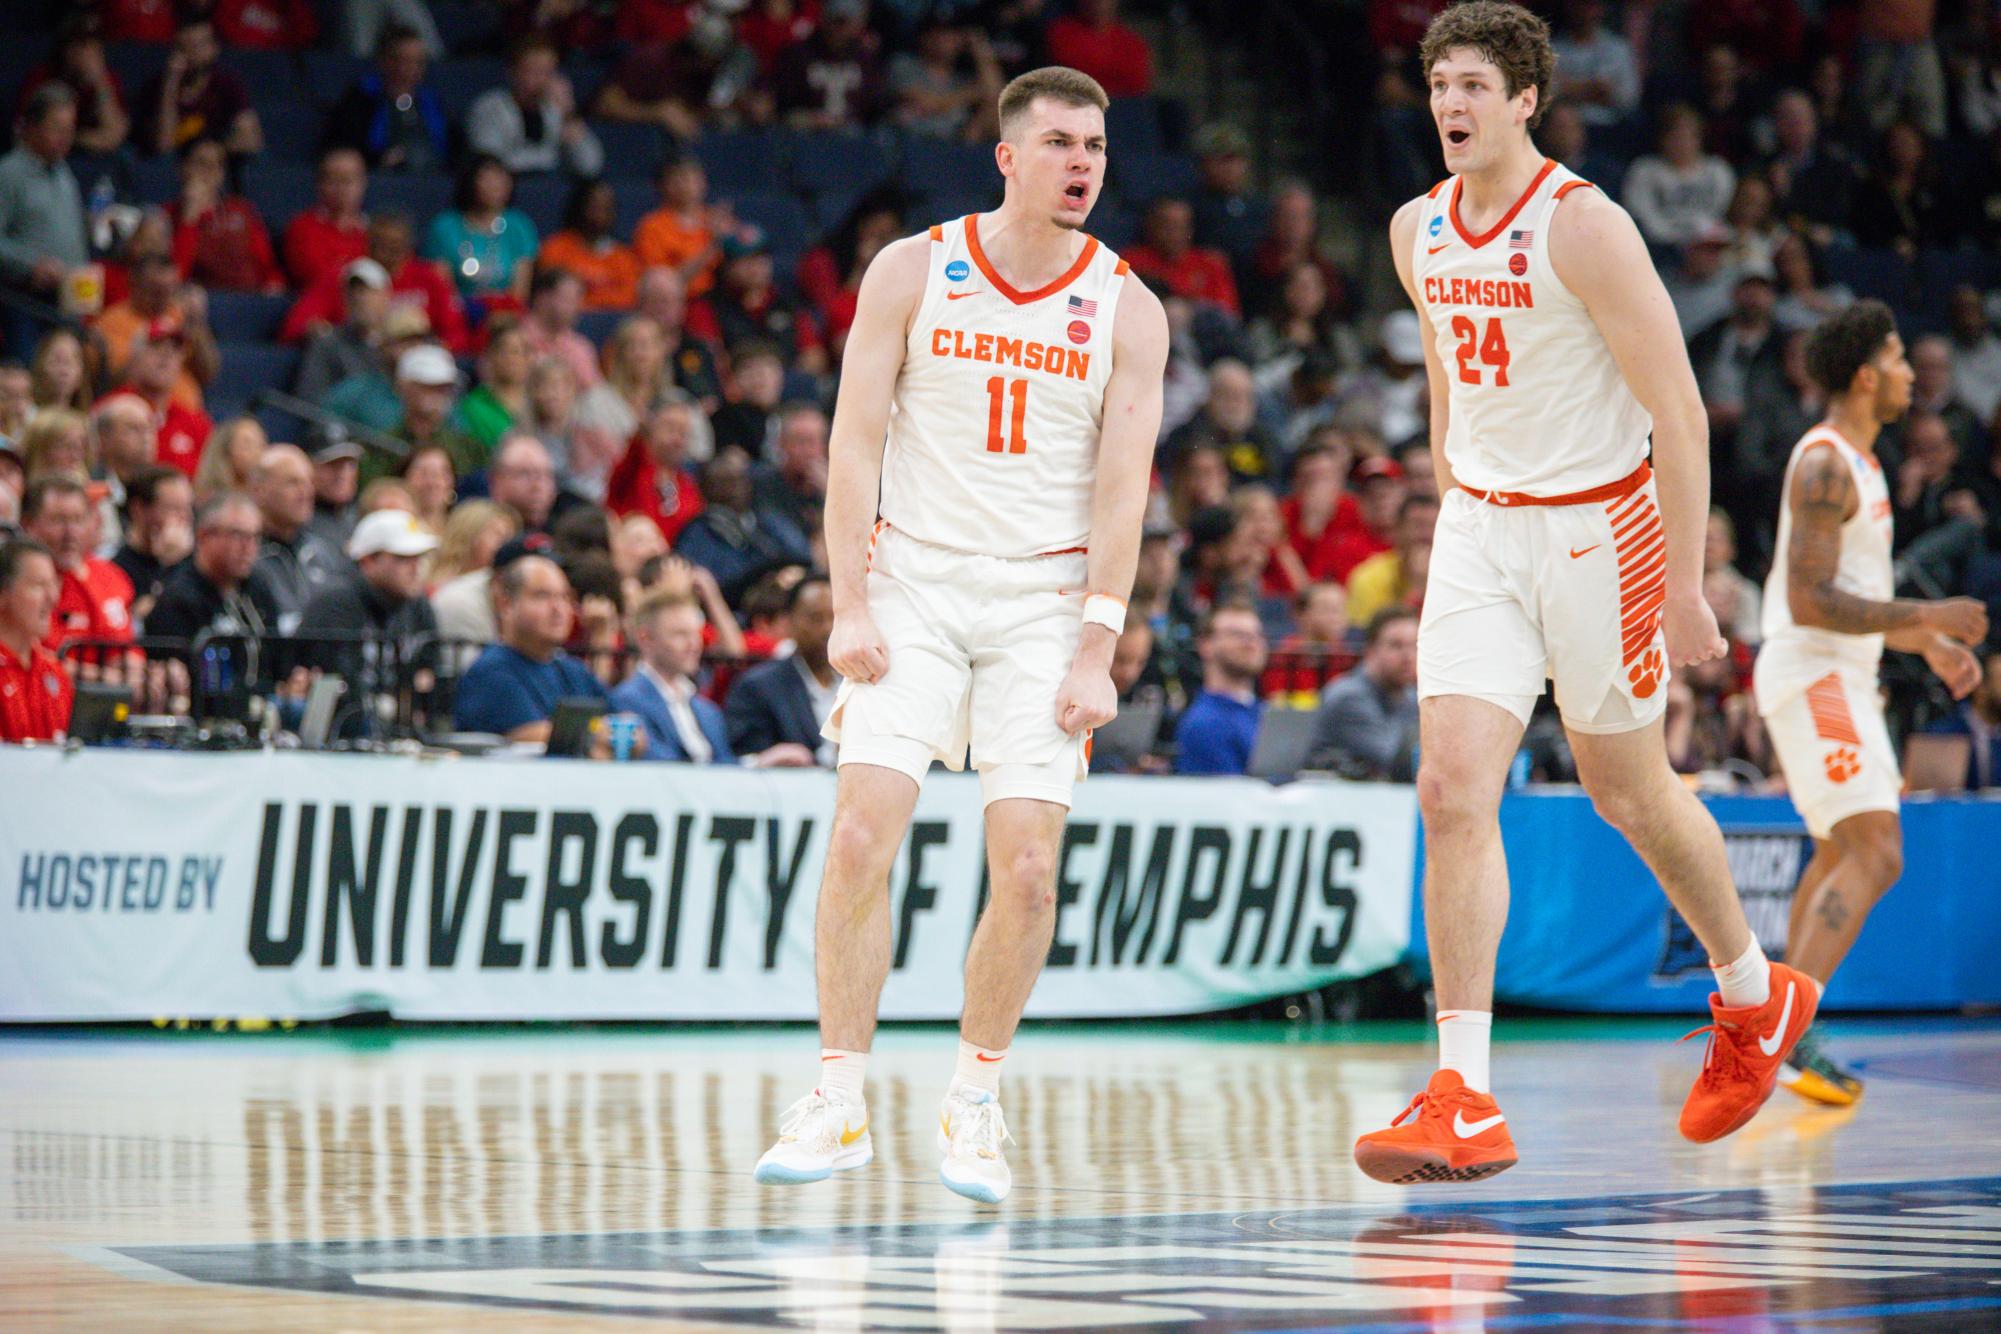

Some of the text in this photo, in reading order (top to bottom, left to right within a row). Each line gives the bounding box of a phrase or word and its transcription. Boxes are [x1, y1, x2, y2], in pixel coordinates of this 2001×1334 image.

[1425, 278, 1534, 308] CLEMSON
[931, 328, 1090, 381] CLEMSON
[1451, 315, 1510, 387] 24
[986, 376, 1029, 454] 11
[18, 853, 168, 911] HOSTED
[175, 856, 224, 911] BY
[247, 803, 813, 969] UNIVERSITY
[971, 823, 1363, 967] EMPHIS
